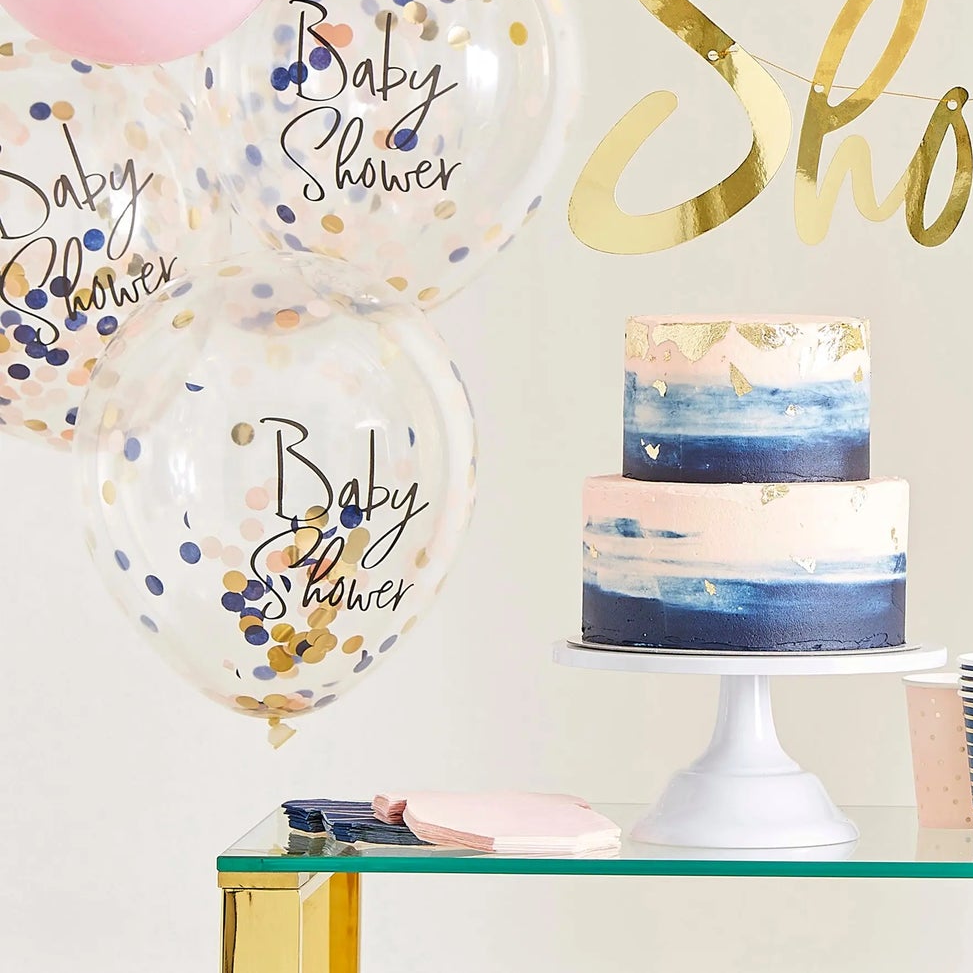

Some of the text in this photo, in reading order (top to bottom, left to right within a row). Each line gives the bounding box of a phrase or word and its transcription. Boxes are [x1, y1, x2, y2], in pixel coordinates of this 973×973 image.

[280, 106, 462, 202] Shower
[0, 236, 178, 346] Shower
[259, 417, 429, 569] Baby
[249, 525, 415, 620] Shower
